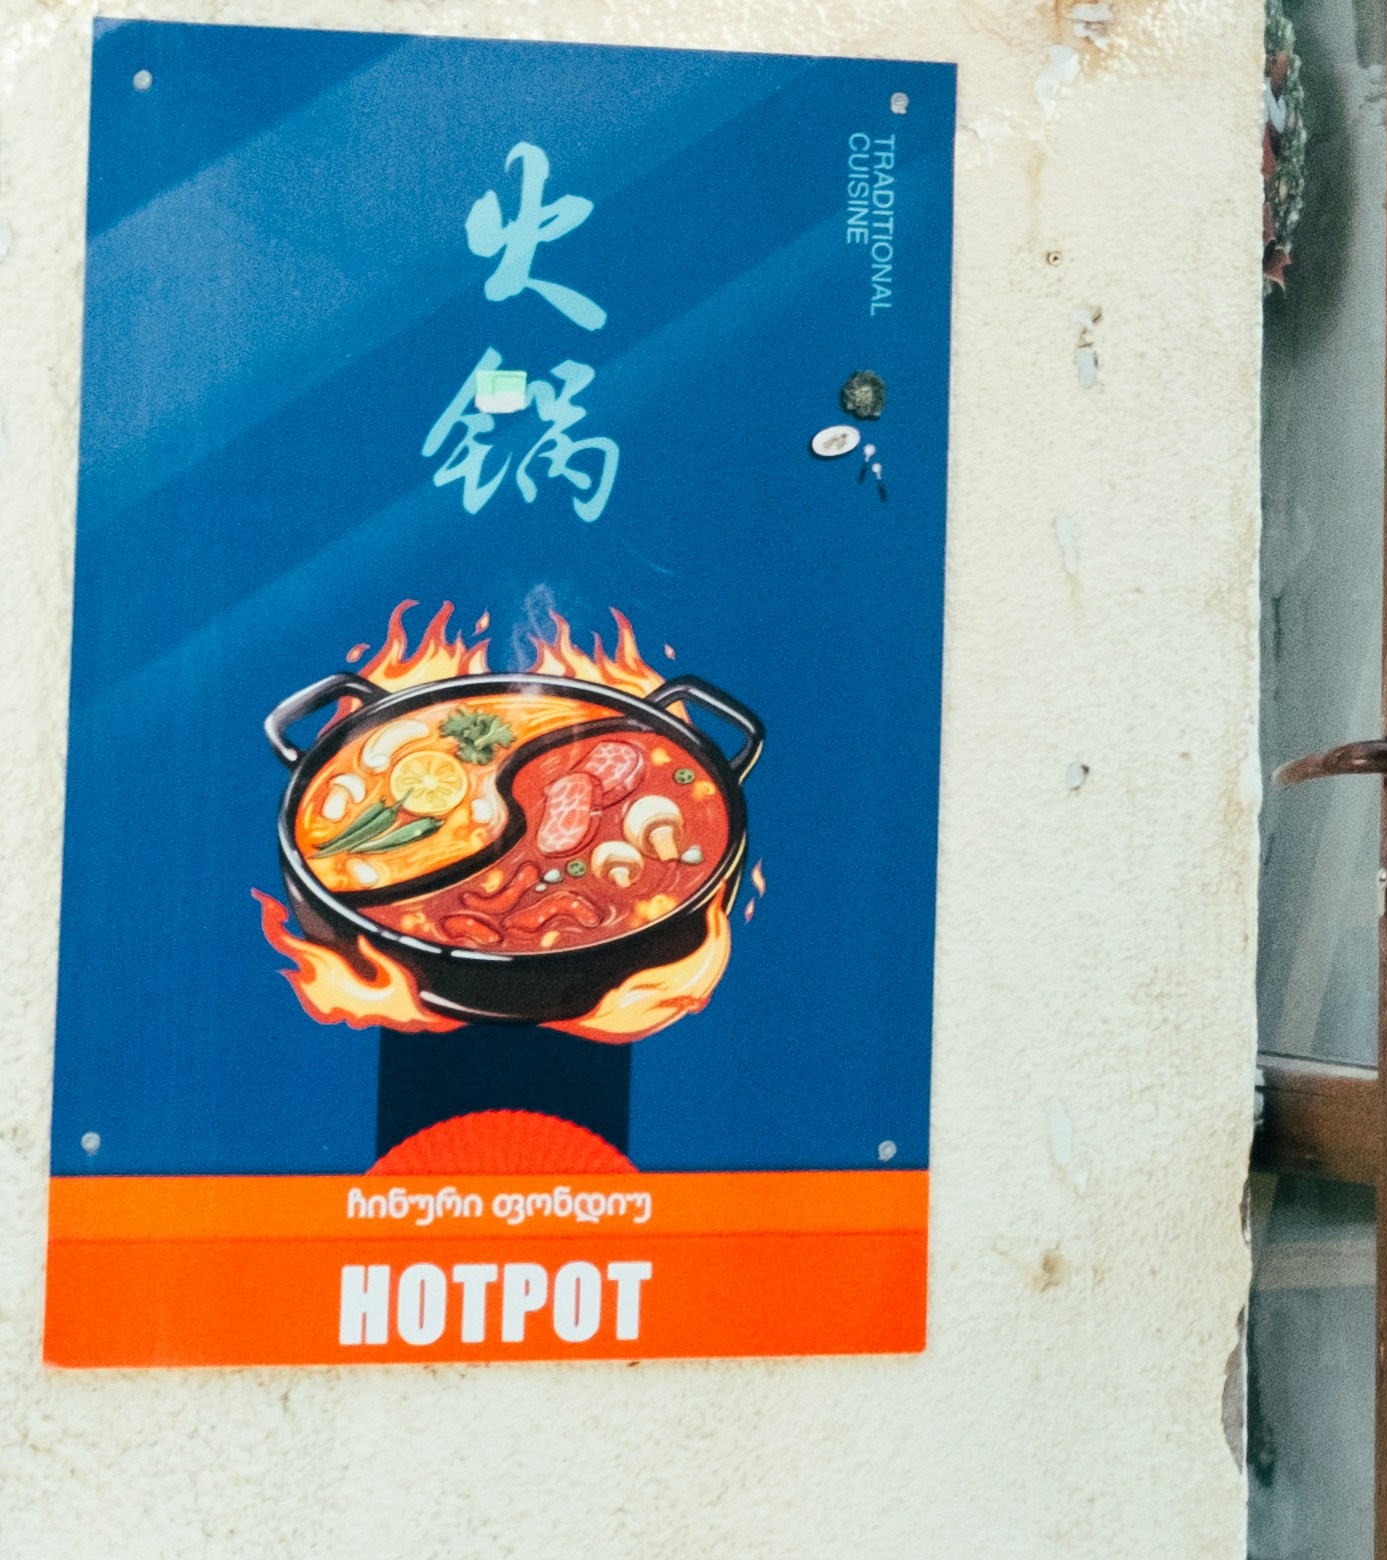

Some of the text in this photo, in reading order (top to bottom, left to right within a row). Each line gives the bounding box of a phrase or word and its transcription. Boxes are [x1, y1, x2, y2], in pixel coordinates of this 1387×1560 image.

[846, 131, 871, 245] CUISINE
[869, 132, 895, 317] TRADITIONAL
[421, 141, 620, 523] 火锅
[347, 1185, 652, 1226] ჩინური ფონდიუ
[339, 1260, 653, 1346] HOTPOT
